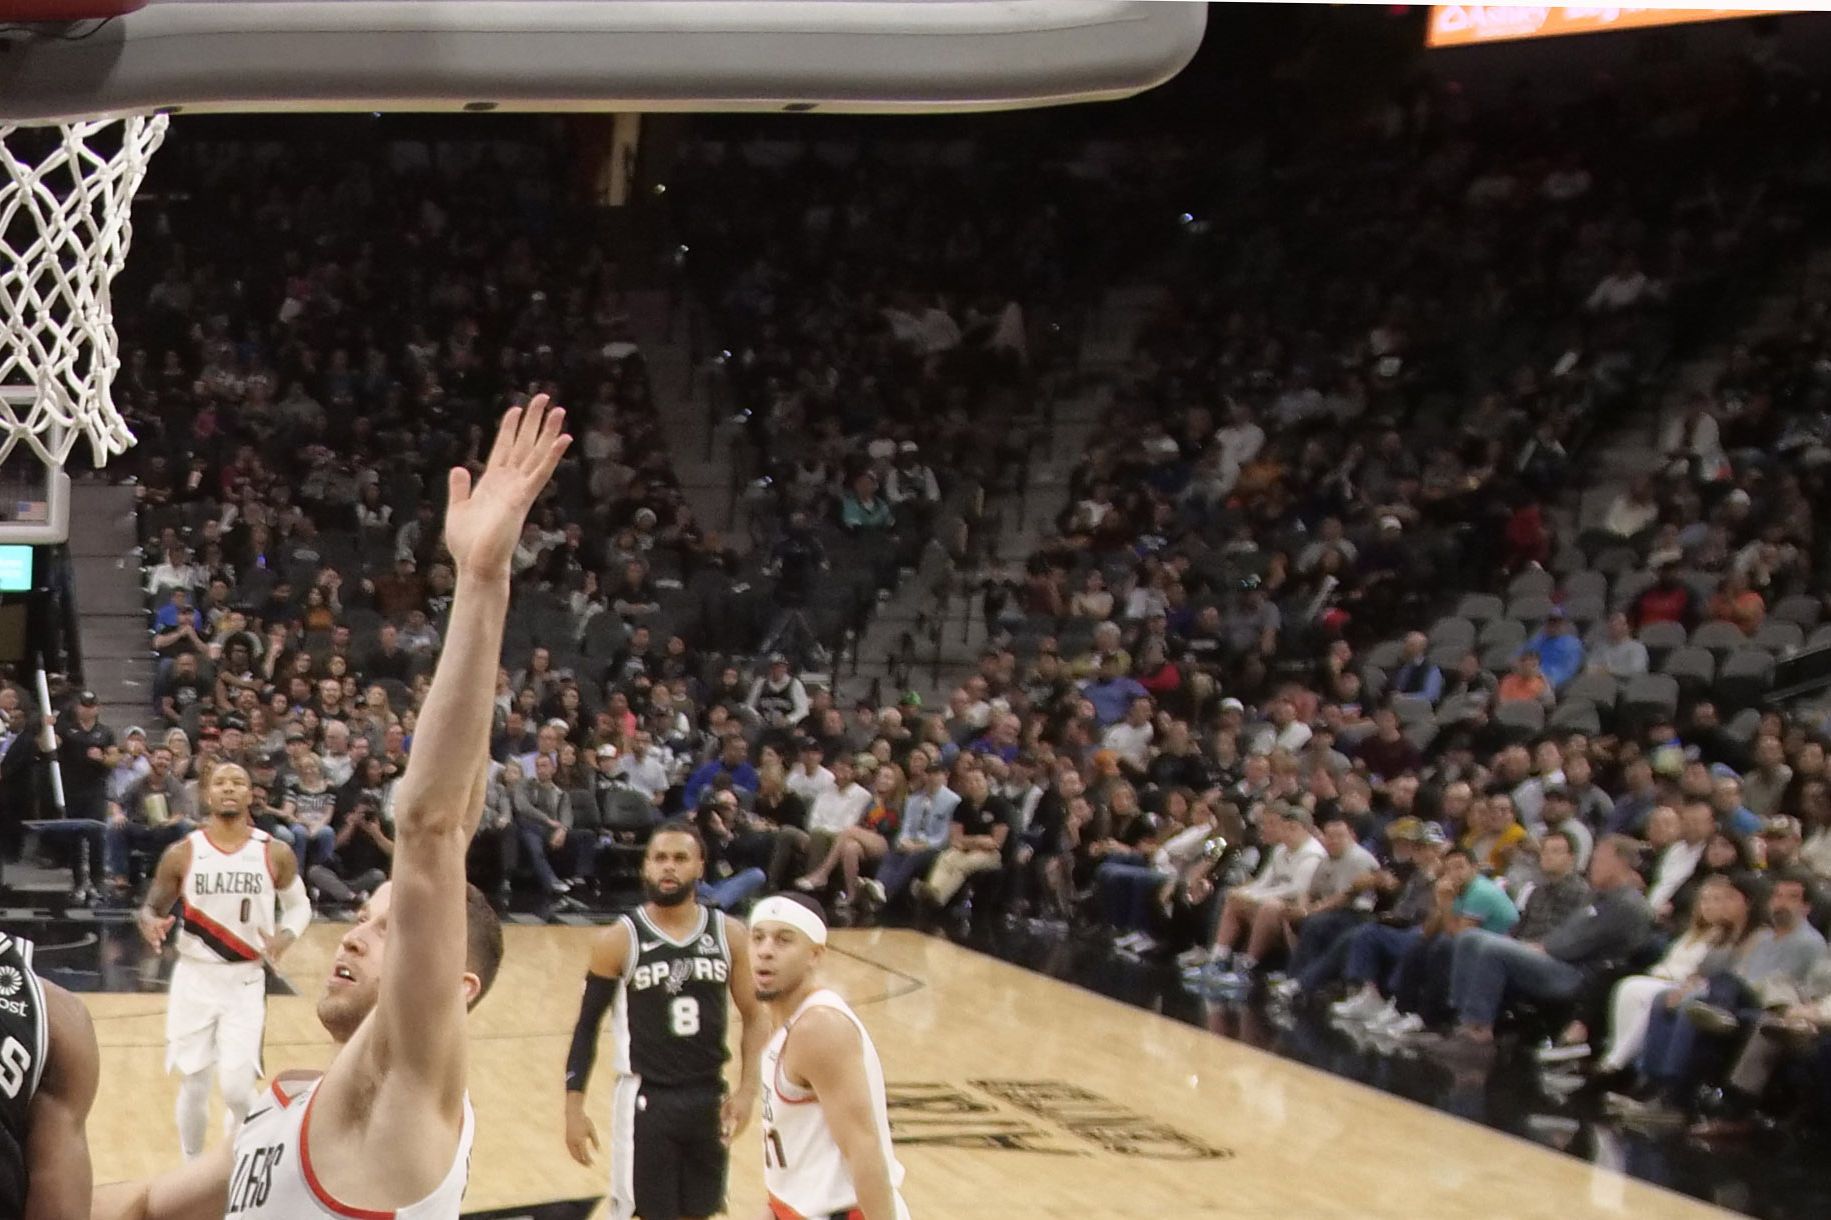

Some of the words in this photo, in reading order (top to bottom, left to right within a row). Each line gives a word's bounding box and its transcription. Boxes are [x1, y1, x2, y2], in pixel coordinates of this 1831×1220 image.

[194, 871, 264, 896] BLAZERS
[238, 897, 252, 924] 0
[633, 956, 728, 994] SPURS
[670, 995, 701, 1037] 8
